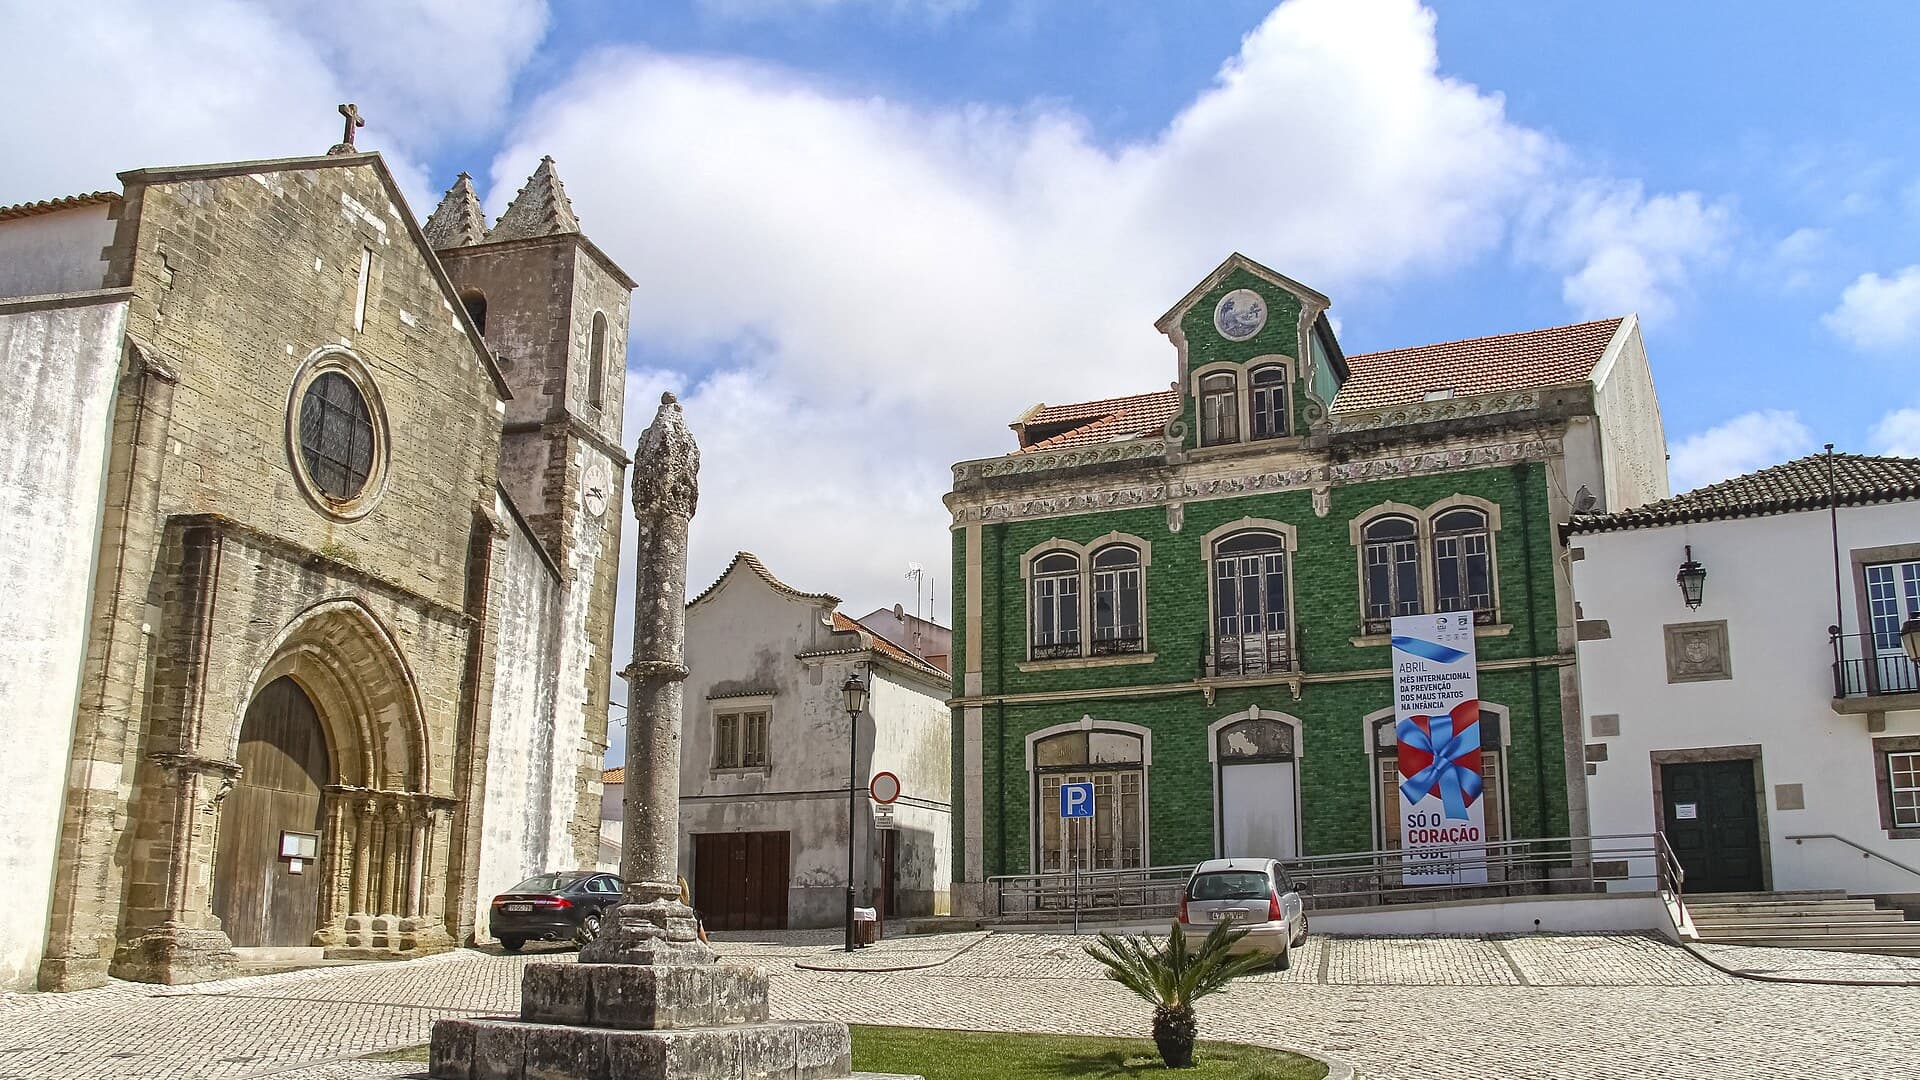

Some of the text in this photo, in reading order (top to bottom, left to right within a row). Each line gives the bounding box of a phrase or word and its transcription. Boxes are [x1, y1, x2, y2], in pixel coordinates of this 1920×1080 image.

[1400, 662, 1427, 673] ABRIL
[1400, 672, 1471, 684] MÊS INTERNACIONAL
[1400, 681, 1451, 693] DA PREVENÇÃO
[1401, 691, 1464, 702] DOS MAUS TRATOS
[1401, 700, 1444, 711] NA INFÂNCIA
[1067, 786, 1087, 815] P
[1407, 810, 1441, 828] SÓ O
[1408, 824, 1479, 845] CORAÇÃO
